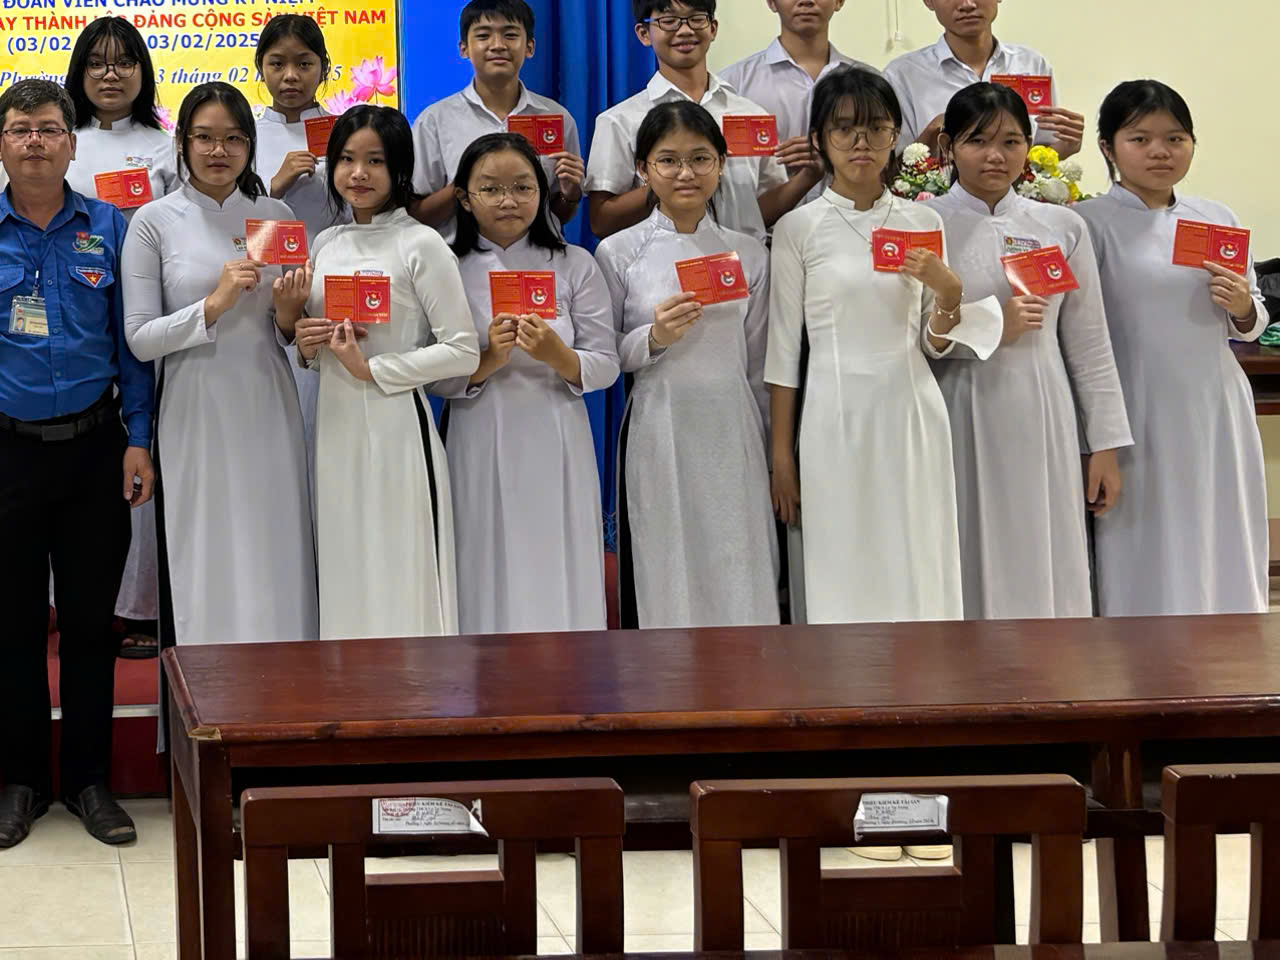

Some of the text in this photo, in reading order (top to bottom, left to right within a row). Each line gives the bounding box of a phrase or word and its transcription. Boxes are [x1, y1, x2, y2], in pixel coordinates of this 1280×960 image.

[23, 12, 87, 31] THÀNH
[134, 11, 185, 28] ĐẢNG
[192, 9, 245, 29] CỘNG
[344, 10, 386, 25] NAM
[228, 67, 249, 83] 02
